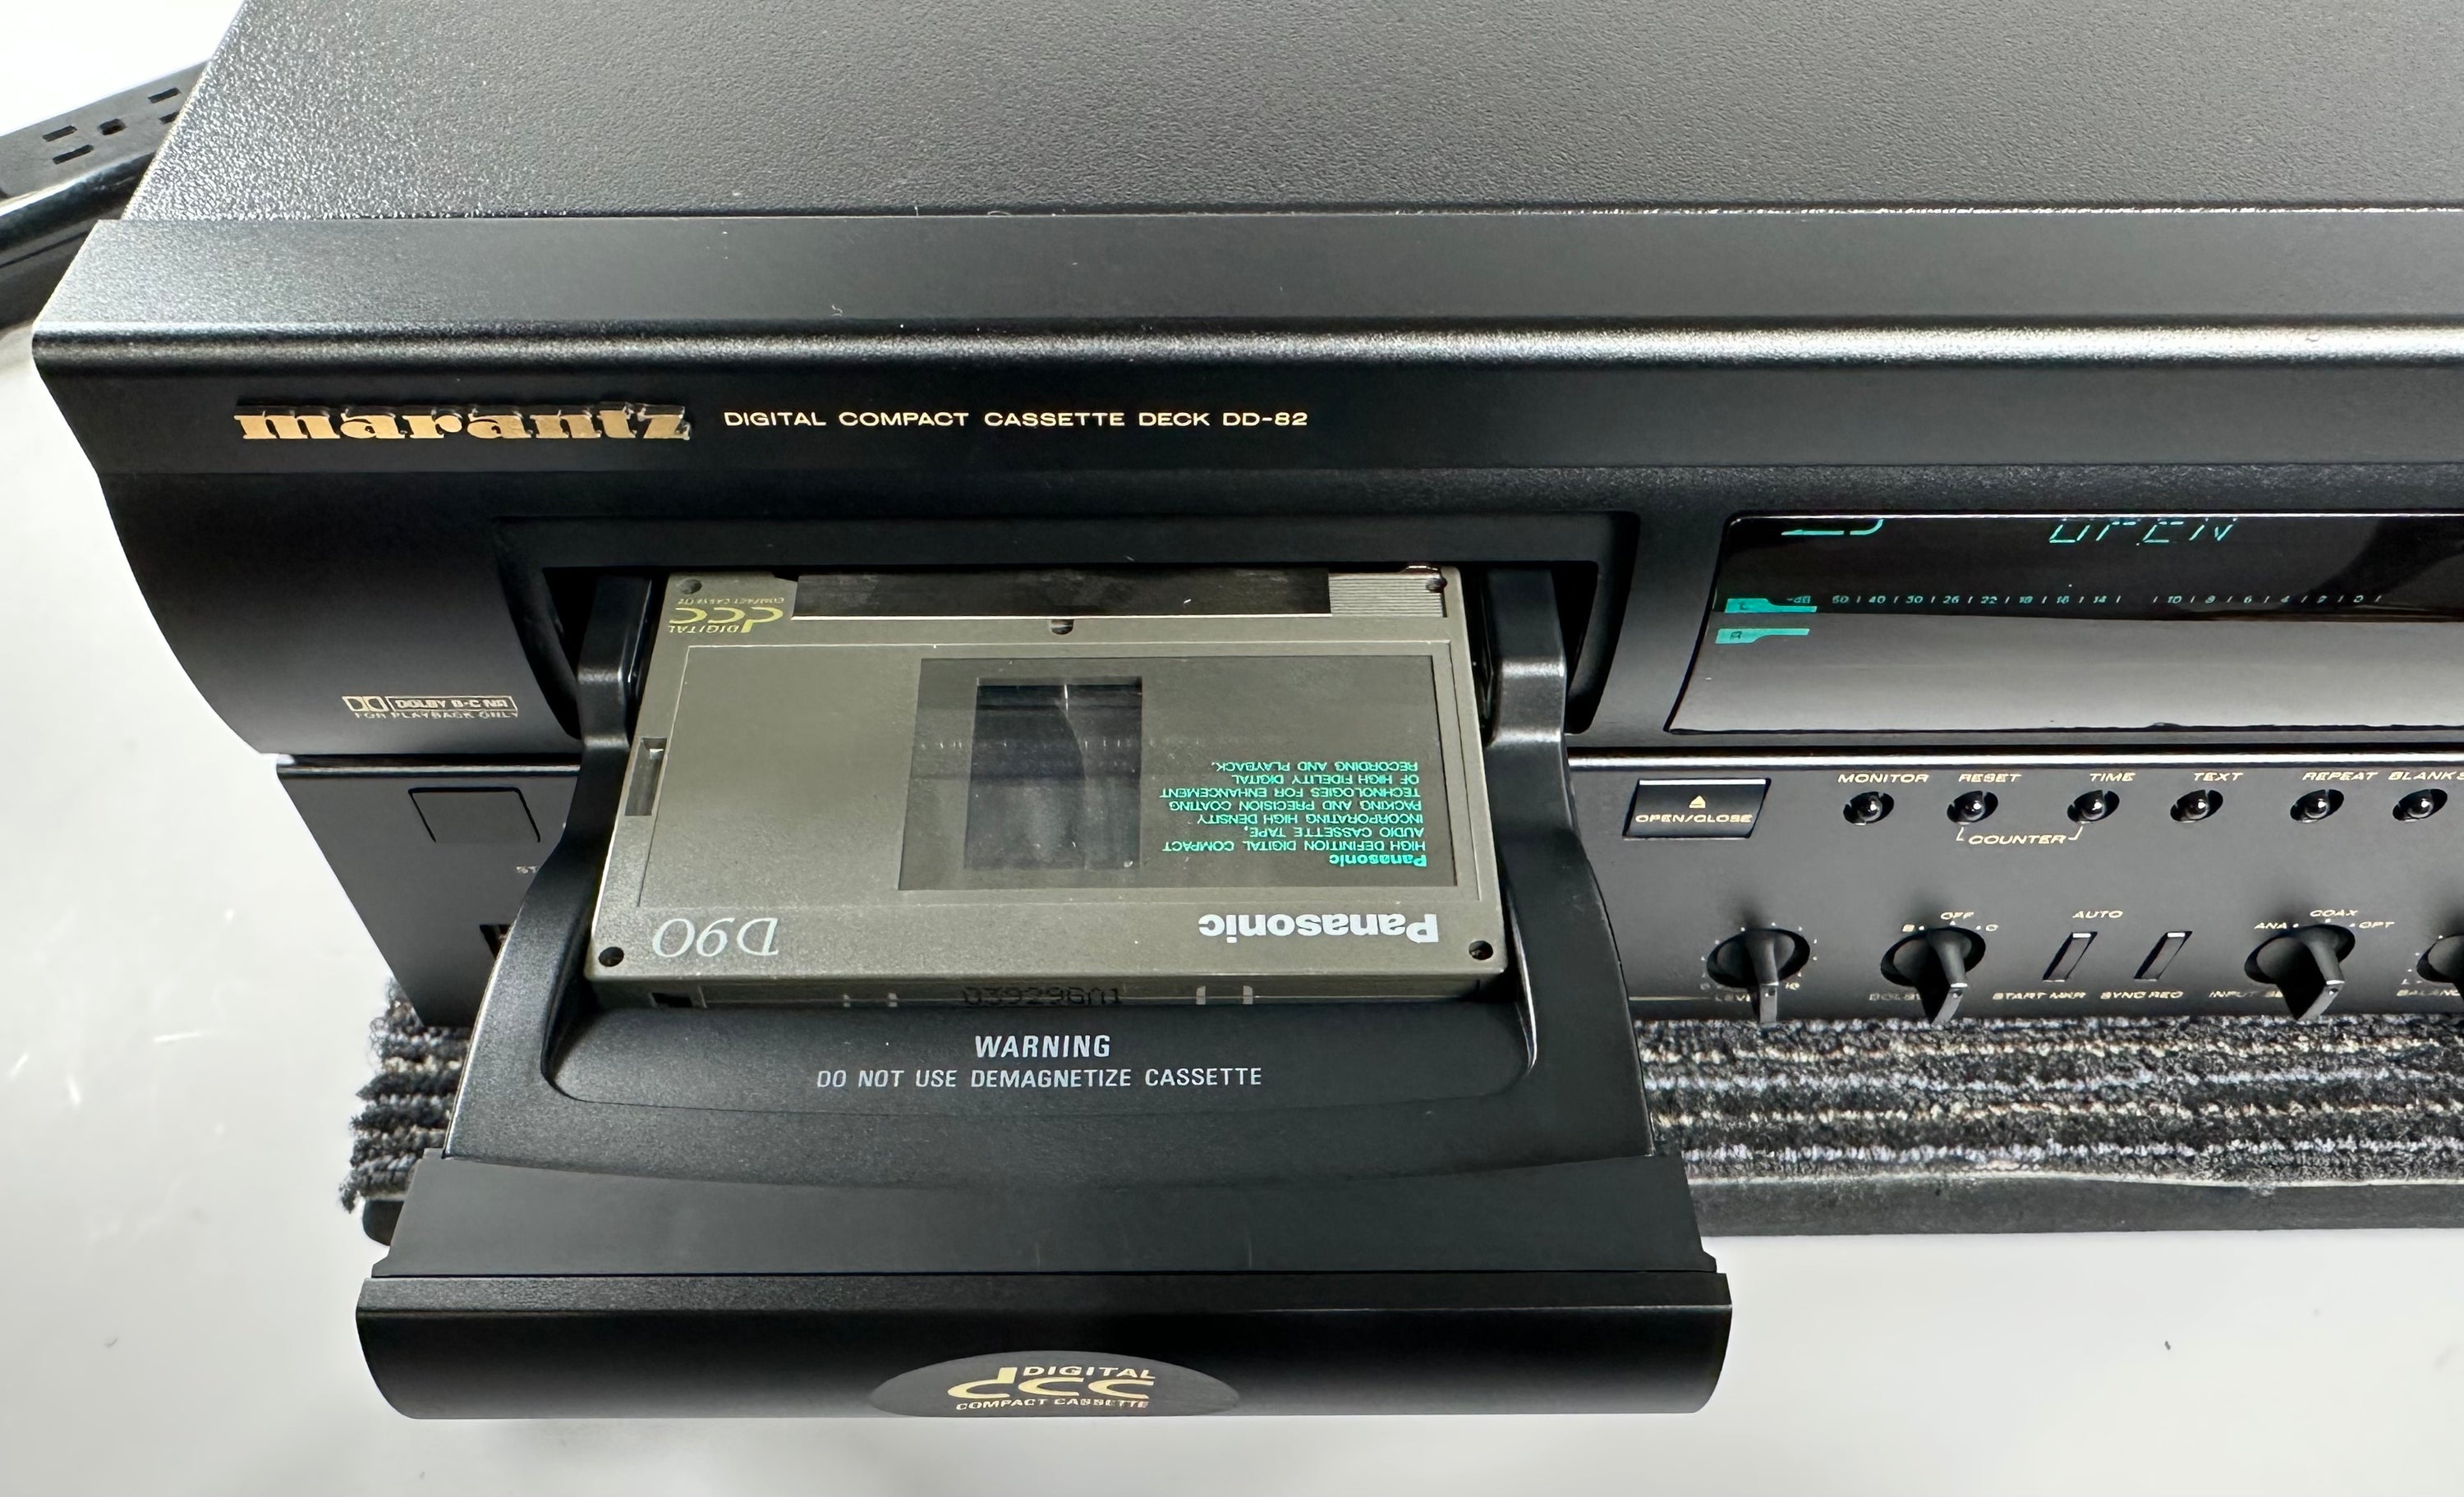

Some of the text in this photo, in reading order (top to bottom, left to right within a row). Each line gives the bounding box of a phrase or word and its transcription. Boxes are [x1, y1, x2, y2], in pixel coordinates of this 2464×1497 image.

[234, 403, 692, 439] marantz
[724, 411, 1308, 427] DIGITAL COMPACT CASSETTE DECK DD-82
[1869, 595, 1887, 604] 40
[1905, 595, 1924, 604] 30
[2167, 595, 2182, 604] 10
[668, 625, 739, 633] DIGITAL
[394, 699, 446, 708] DOLBY
[392, 711, 475, 719] PLAYBACK
[1211, 761, 1418, 772] RECORDING AND PLAYBACK.
[1232, 774, 1419, 784] OF HIGH FIDELITY DIGITAL
[1837, 774, 1929, 783] MONITOR
[1958, 773, 2022, 783] RESET
[2089, 772, 2136, 782] TIME
[2193, 772, 2243, 782] TEXT
[2301, 772, 2379, 781] REPEAT
[1159, 788, 1420, 798] TECHNOLOGIES FOR ENHANCEMENT
[1169, 801, 1422, 811] PACKING AND PRECISION COATING
[1197, 814, 1423, 824] INCORPORATING HIGH DENSITY
[1635, 814, 1754, 823] OPEN/CLOSE
[1244, 825, 1424, 838] AUDIO CASSETTE TAPE,
[1968, 834, 2068, 845] COUNTER
[1161, 841, 1426, 852] HIGH DEFINITION DIGITAL COMPACT
[1329, 854, 1427, 867] Panasonic
[1940, 912, 1974, 920] OFF
[2071, 909, 2124, 919] AUTO
[2310, 909, 2359, 917] COAX
[1198, 913, 1439, 944] Panasonic
[2254, 921, 2287, 930] ANA
[2359, 921, 2395, 930] OPT
[652, 917, 779, 957] D90
[1992, 992, 2047, 1000] START
[2100, 990, 2184, 1000] SYNC REC
[974, 1035, 1111, 1058] WARNING
[816, 1068, 1262, 1088] DO NOT USE DEMAGNETIZE CASSETTE
[1023, 1366, 1156, 1380] DIGITAL
[955, 1398, 1151, 1411] COMPACT CASSETTE
